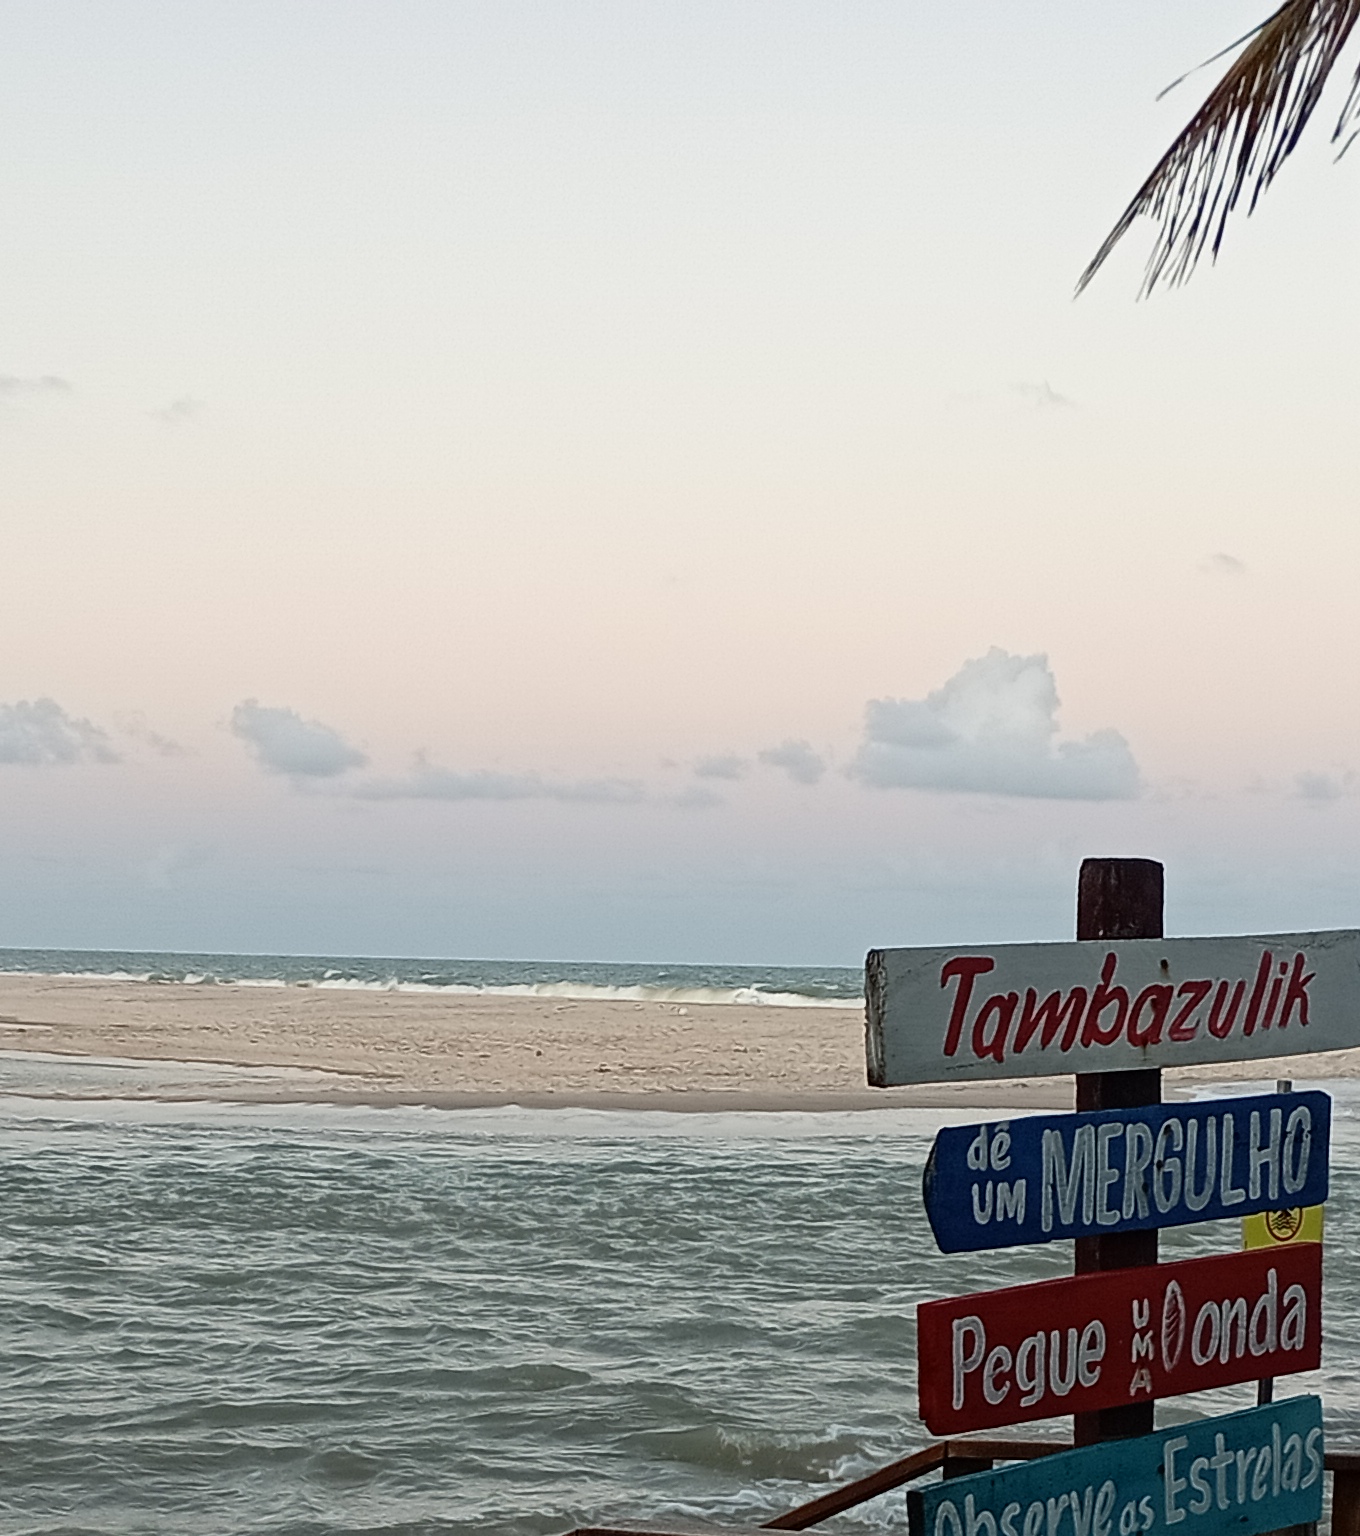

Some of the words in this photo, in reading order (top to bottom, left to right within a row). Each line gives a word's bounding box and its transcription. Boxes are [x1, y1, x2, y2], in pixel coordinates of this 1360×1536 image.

[940, 951, 1316, 1063] Tambazulik
[1042, 1106, 1312, 1232] MERGULHO
[952, 1315, 1106, 1411] Pegue
[1192, 1268, 1307, 1366] onda
[1119, 1495, 1155, 1536] as
[1163, 1422, 1321, 1526] Estrelas
